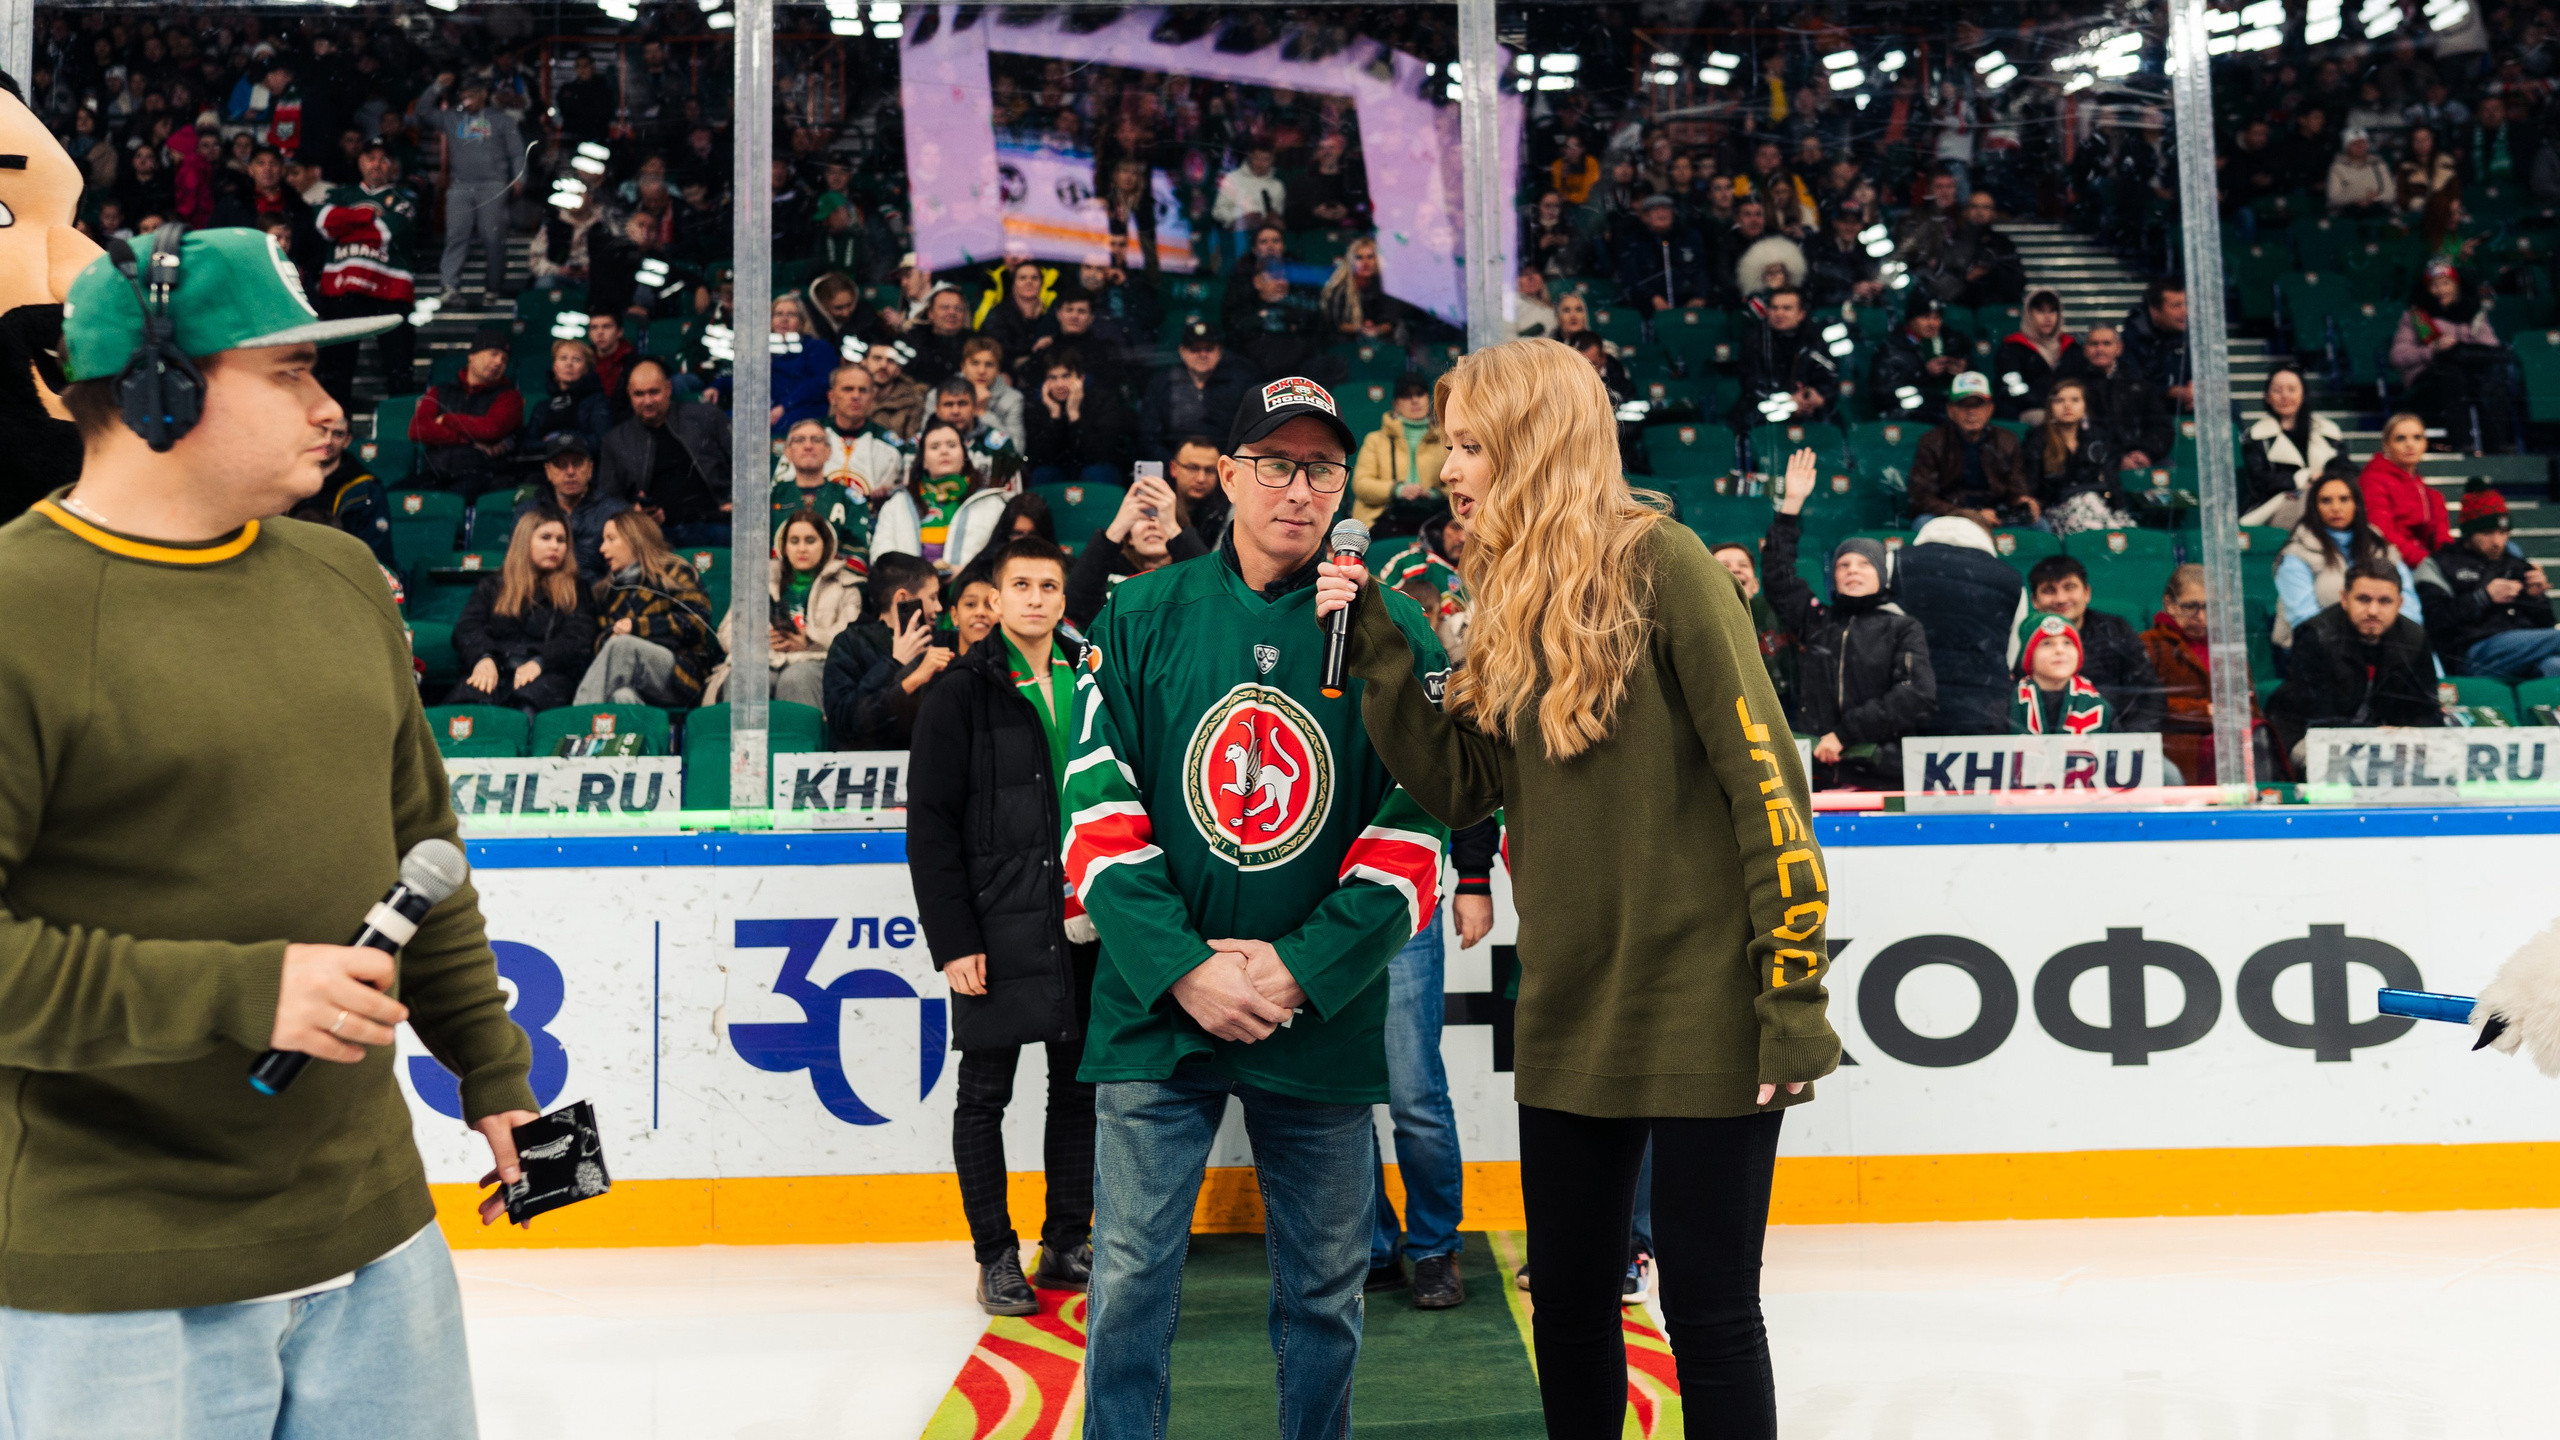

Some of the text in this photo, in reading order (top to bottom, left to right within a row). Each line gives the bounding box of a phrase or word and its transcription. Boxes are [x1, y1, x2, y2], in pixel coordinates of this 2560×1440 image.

[1922, 749, 2147, 796] KHL.RU
[2325, 742, 2547, 788] KHL.RU
[447, 772, 664, 817] KHL.RU
[847, 916, 929, 950] ле
